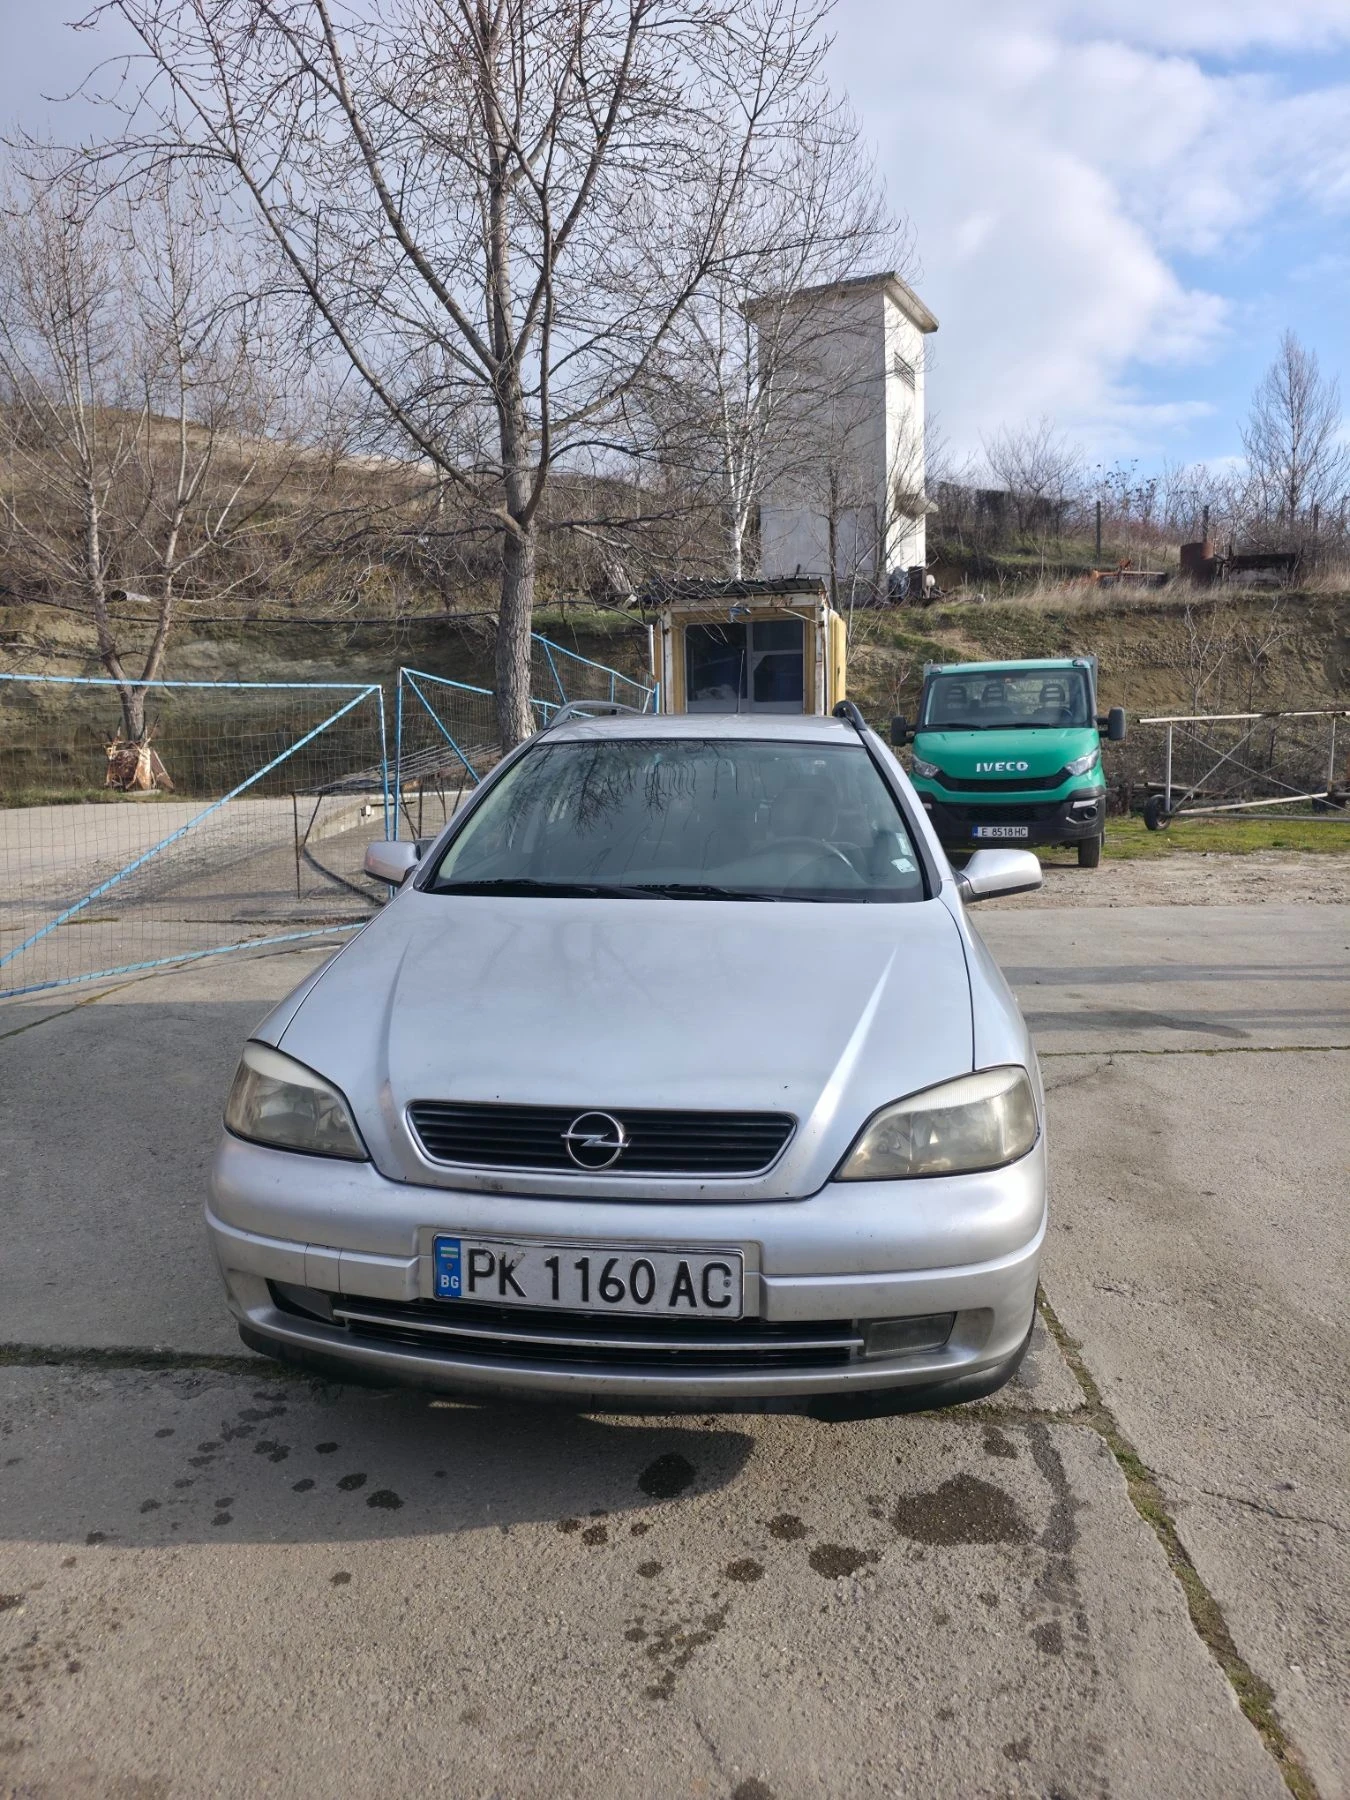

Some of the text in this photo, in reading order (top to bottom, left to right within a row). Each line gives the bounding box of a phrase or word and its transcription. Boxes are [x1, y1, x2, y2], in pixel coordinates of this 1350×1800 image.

[976, 761, 1029, 772] IVECO
[981, 827, 988, 837] E
[440, 1274, 459, 1289] BG
[468, 1248, 732, 1308] PK 1160 AC
